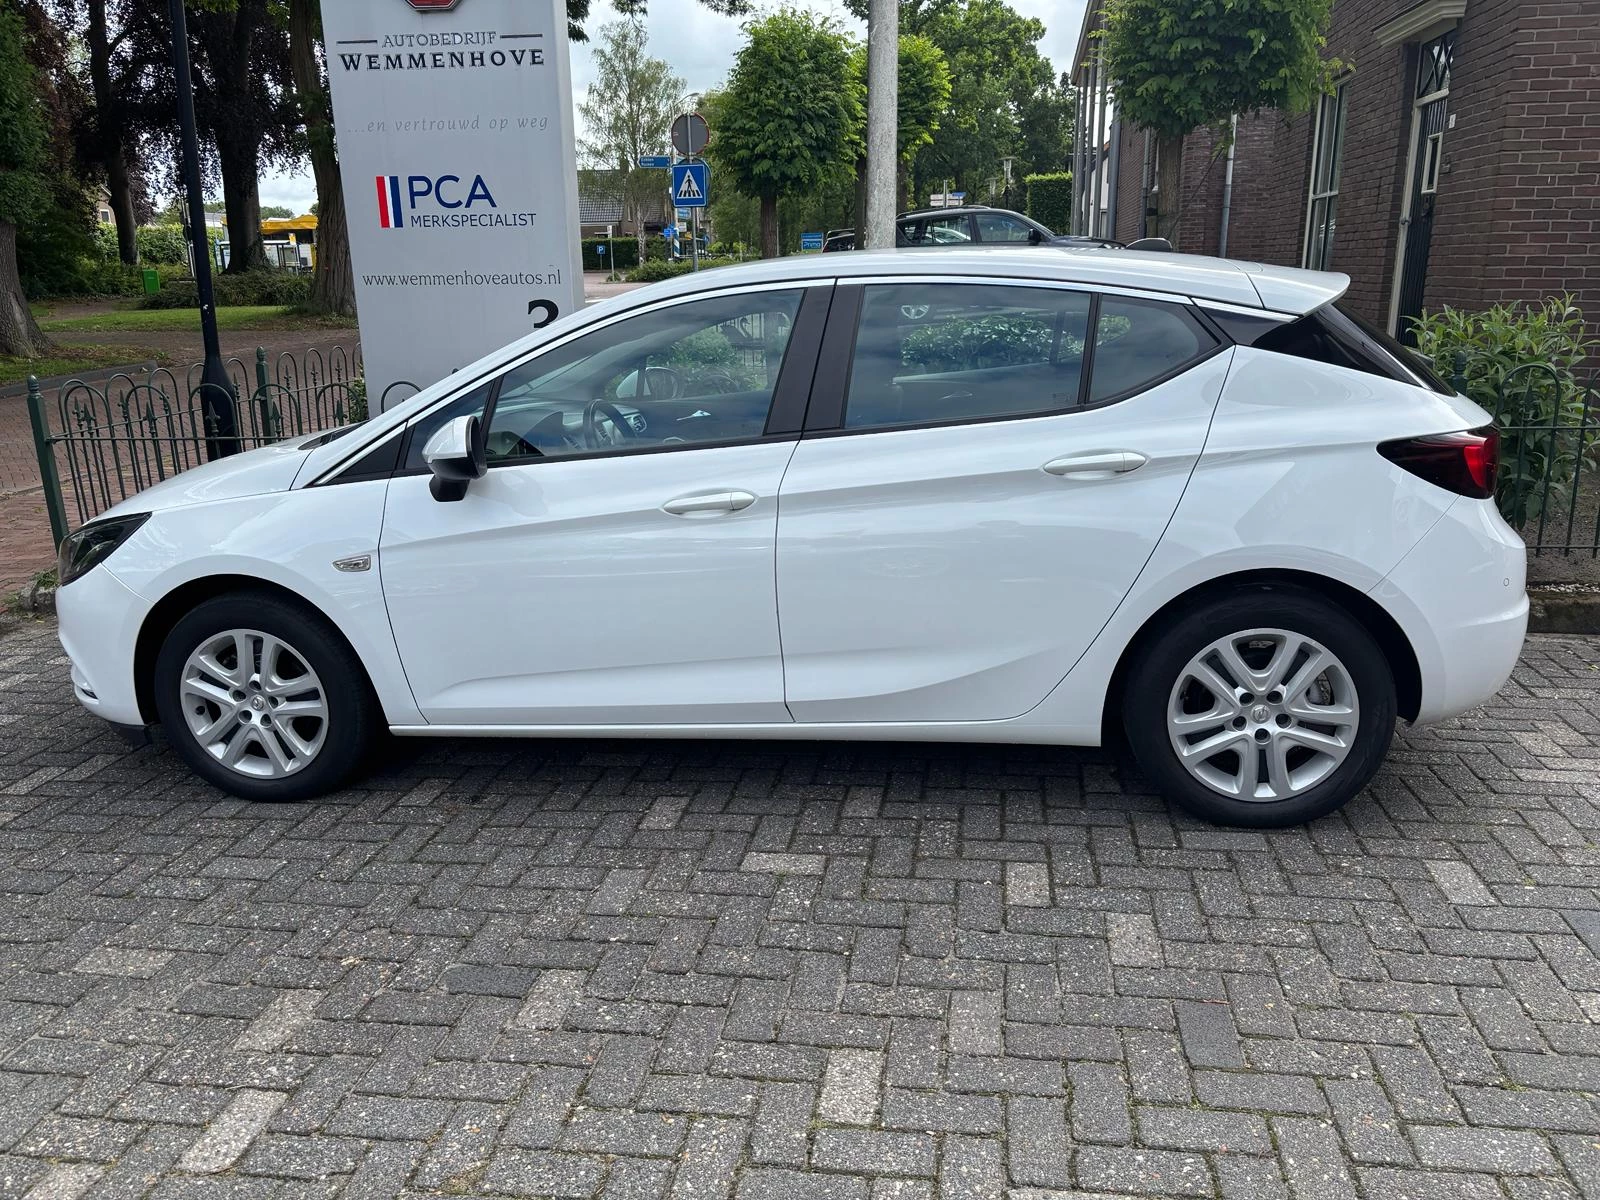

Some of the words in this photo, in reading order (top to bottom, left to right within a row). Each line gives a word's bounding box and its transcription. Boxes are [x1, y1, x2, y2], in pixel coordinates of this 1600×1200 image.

[382, 31, 497, 48] AUTOBEDRIJF
[339, 48, 545, 72] WEMMENHOVE
[395, 114, 480, 131] vertrouwd
[488, 116, 509, 130] op
[517, 114, 549, 131] weg
[407, 174, 498, 210] PCA
[410, 212, 537, 229] MERKSPECIALIST
[361, 268, 562, 287] www.wemmenhoveautos.nl
